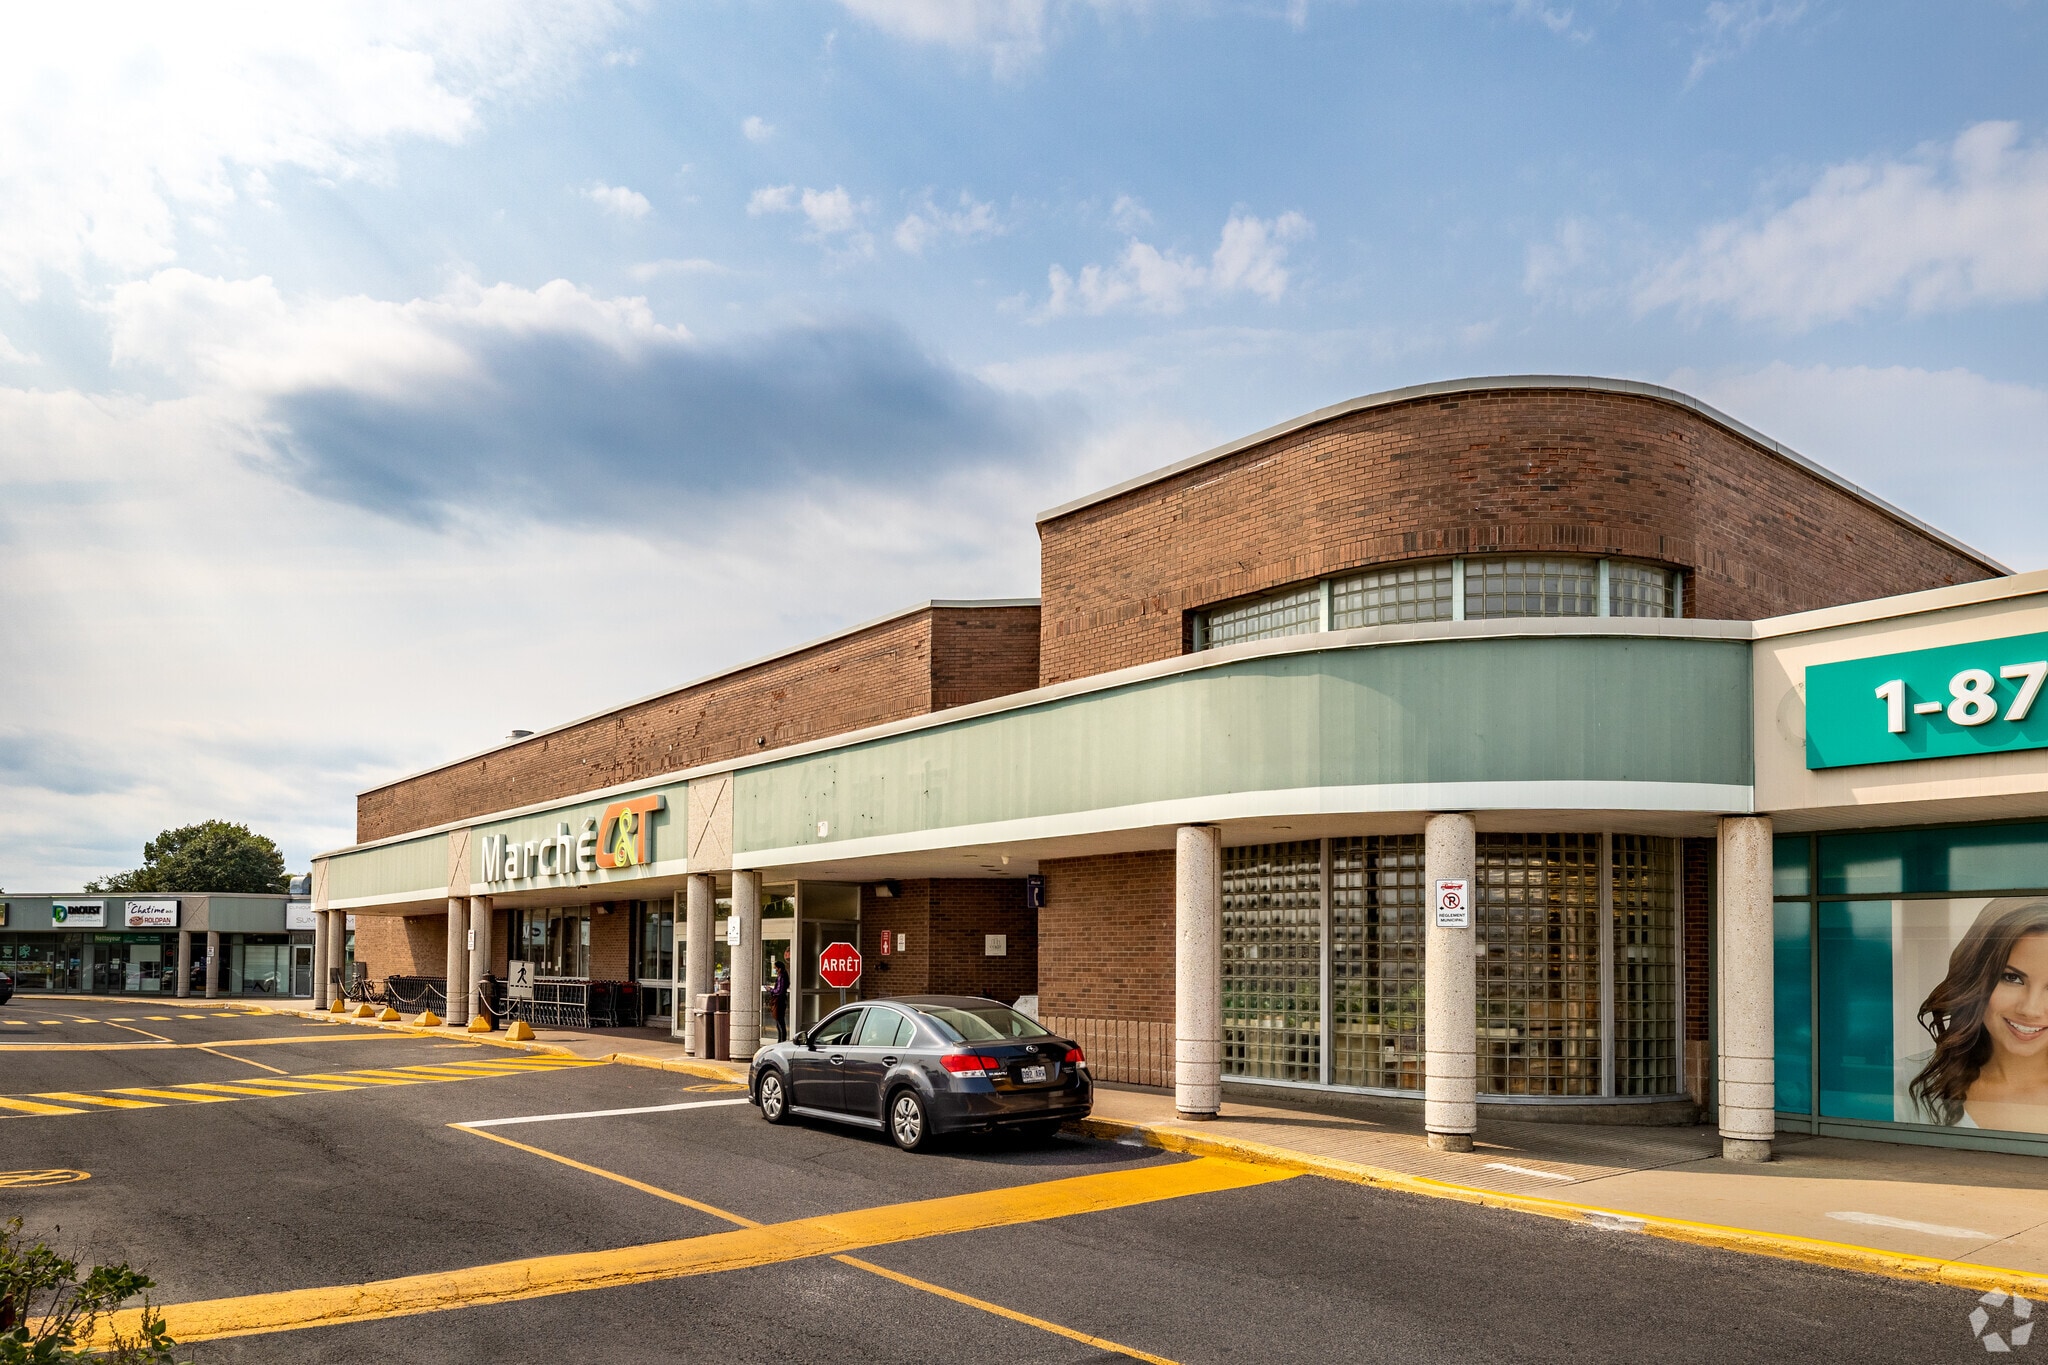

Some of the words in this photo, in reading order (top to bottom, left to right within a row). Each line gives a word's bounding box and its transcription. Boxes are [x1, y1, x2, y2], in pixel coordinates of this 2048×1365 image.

[1874, 660, 2048, 733] 1-87
[481, 816, 597, 883] Marché
[67, 906, 102, 914] DAOUST
[129, 904, 165, 914] Chatime
[822, 956, 860, 972] ARRÊT
